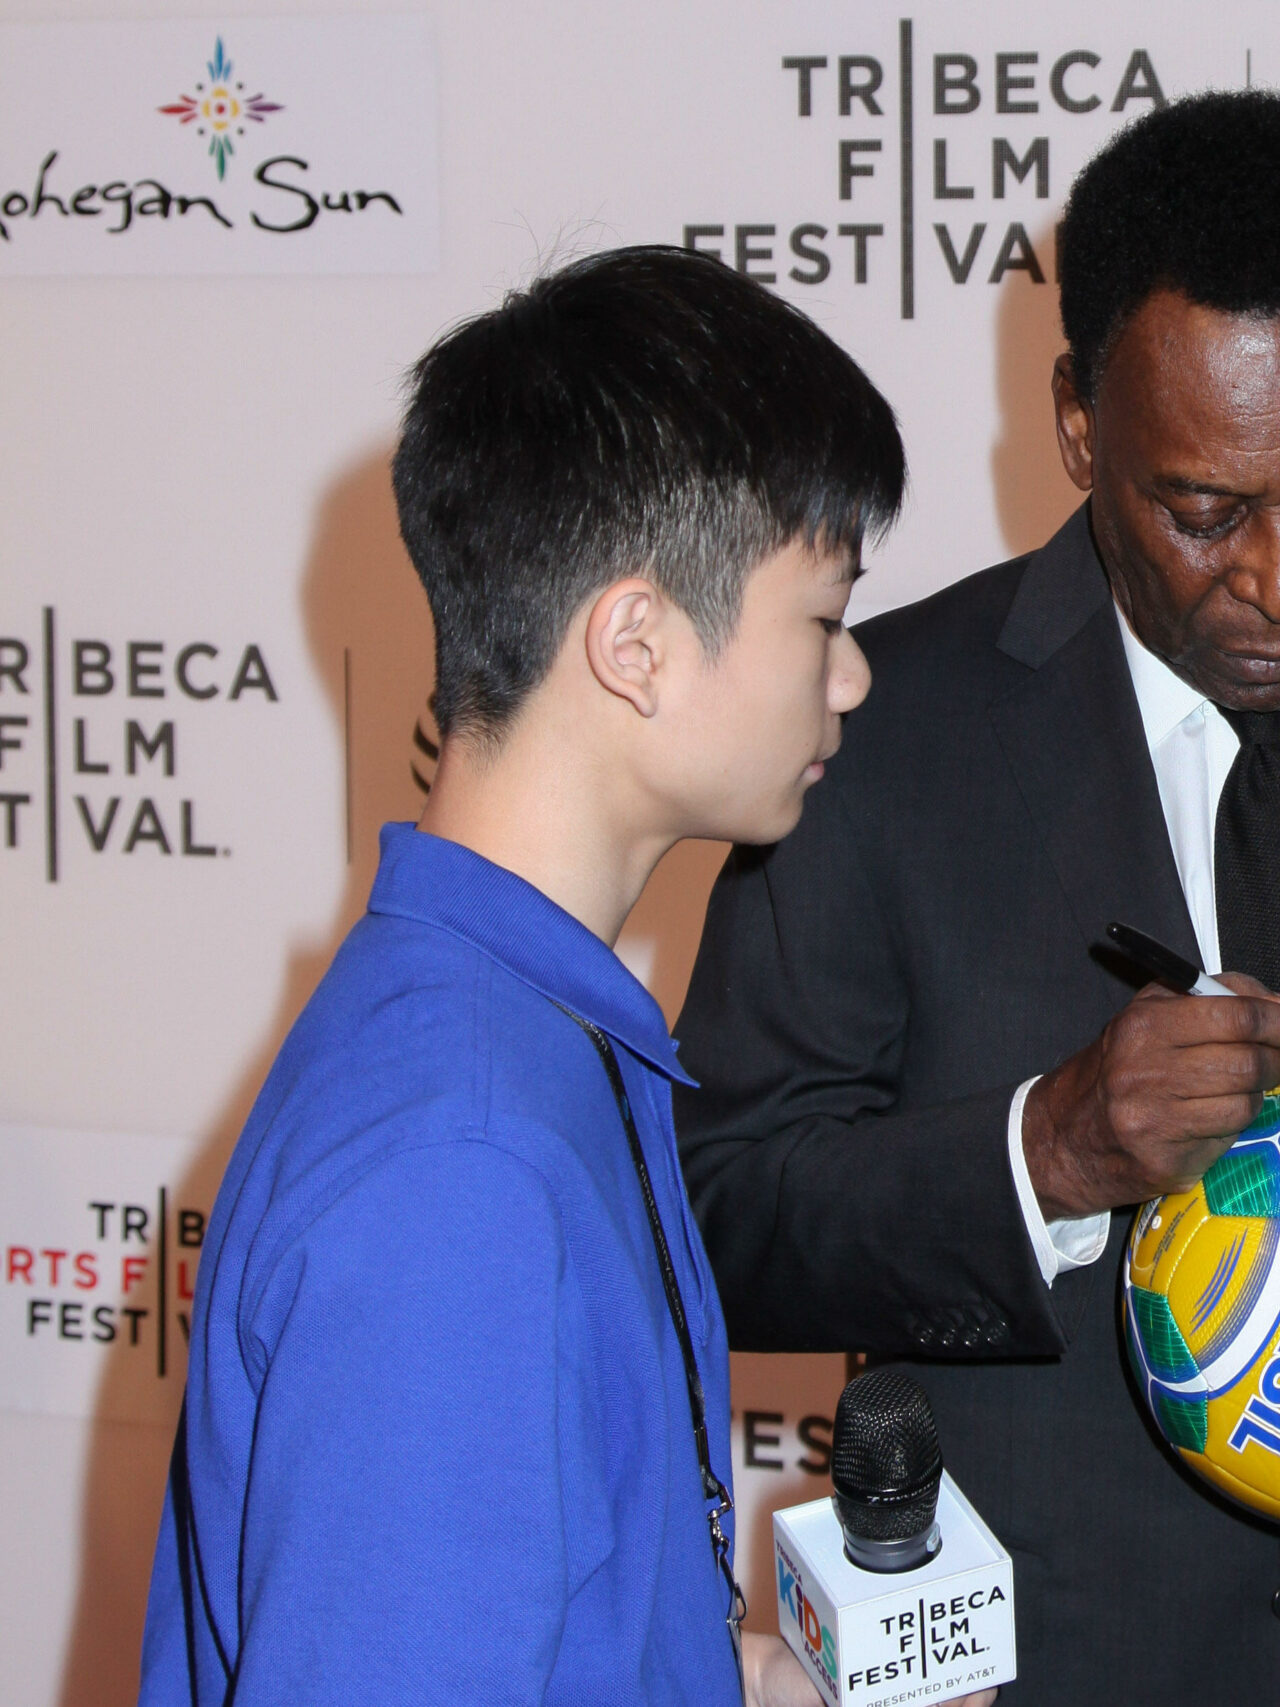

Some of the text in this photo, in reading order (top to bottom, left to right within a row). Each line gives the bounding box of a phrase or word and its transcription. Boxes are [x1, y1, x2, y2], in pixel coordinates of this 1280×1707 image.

[0, 150, 403, 240] ohegan Sun
[7, 1246, 99, 1290] RTS
[945, 1675, 963, 1689] BY
[966, 1665, 997, 1683] AT&T
